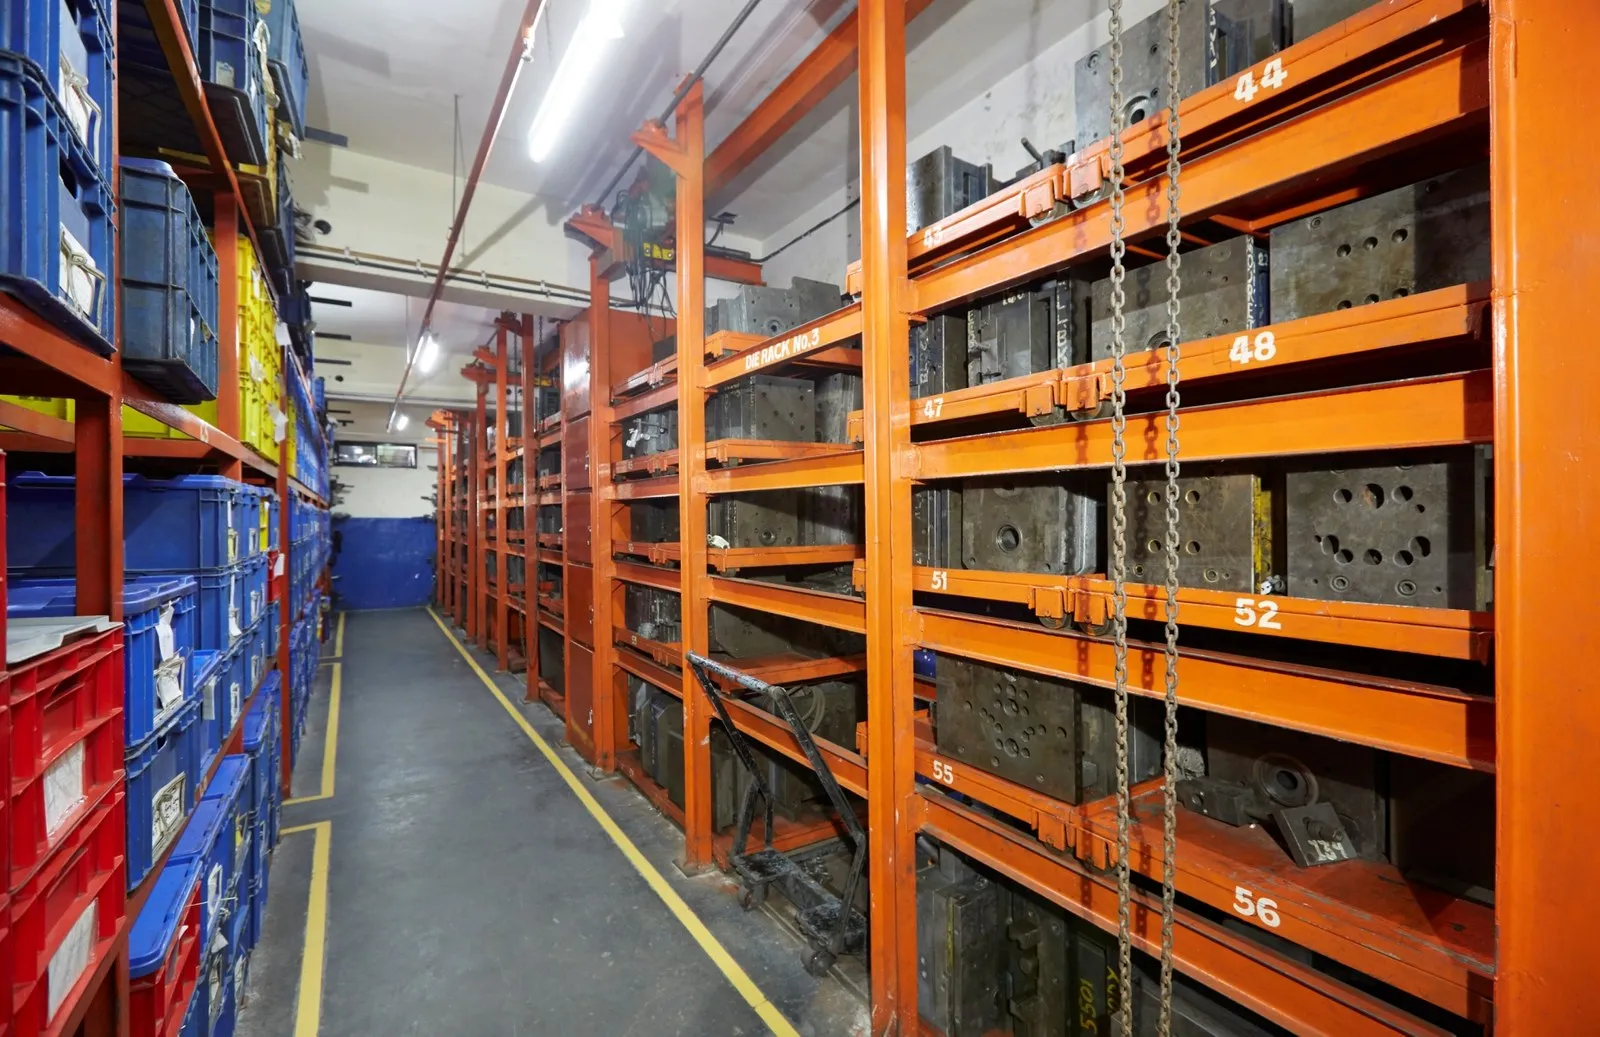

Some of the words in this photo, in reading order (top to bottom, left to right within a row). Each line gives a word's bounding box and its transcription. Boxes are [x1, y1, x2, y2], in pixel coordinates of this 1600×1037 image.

[1234, 57, 1288, 103] 44
[745, 351, 761, 371] DIE
[761, 339, 791, 365] RACK
[1229, 331, 1277, 364] 48
[923, 397, 944, 418] 47
[931, 570, 947, 590] 51
[1234, 597, 1281, 630] 52
[933, 759, 954, 785] 55
[1232, 885, 1281, 928] 56
[1078, 976, 1098, 1036] 5501
